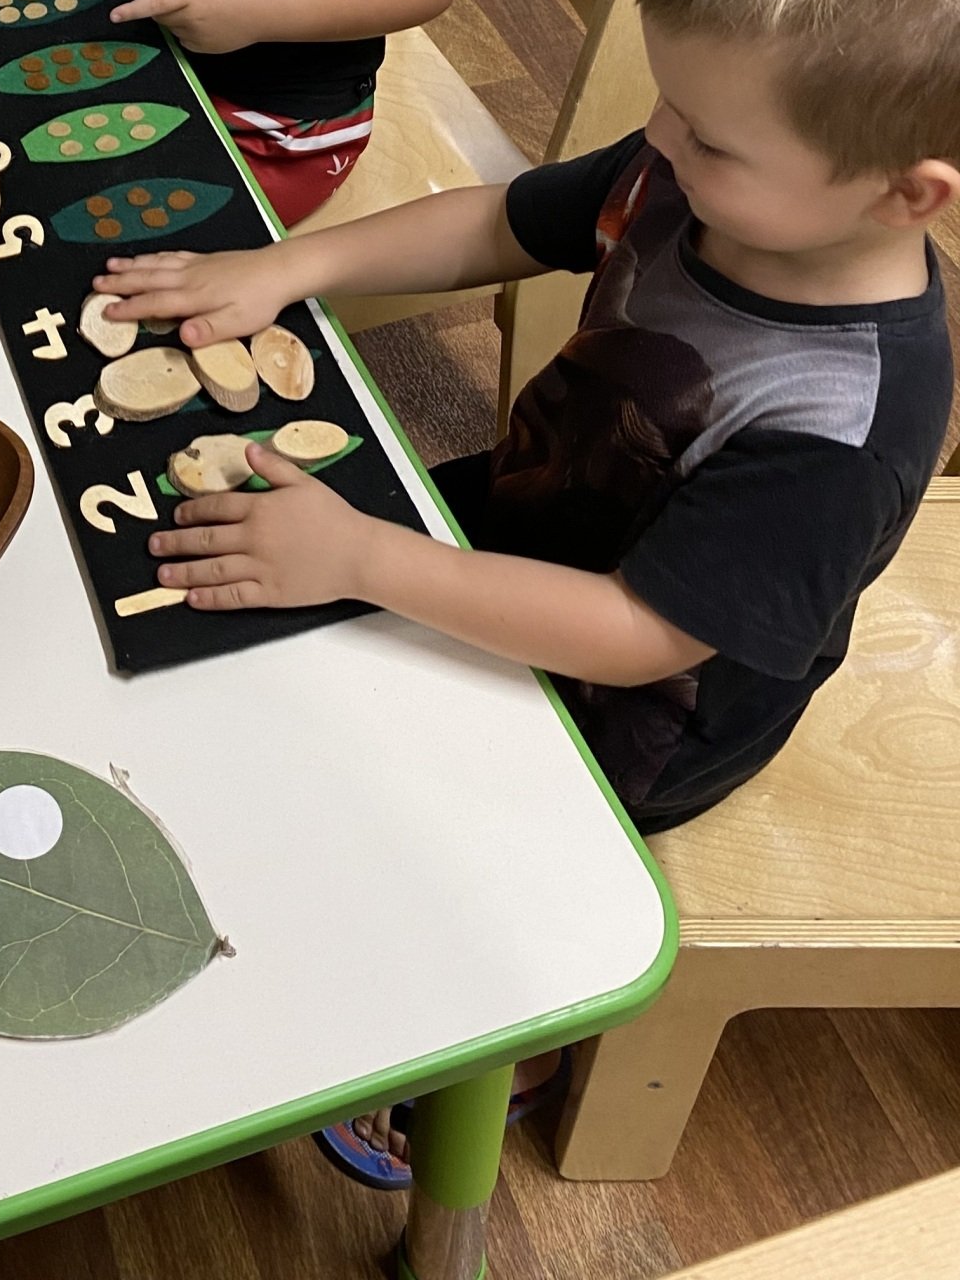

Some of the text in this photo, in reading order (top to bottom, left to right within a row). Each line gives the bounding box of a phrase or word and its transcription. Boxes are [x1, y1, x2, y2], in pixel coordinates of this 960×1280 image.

[22, 307, 67, 361] 4
[44, 393, 115, 448] 3
[79, 470, 159, 534] 2
